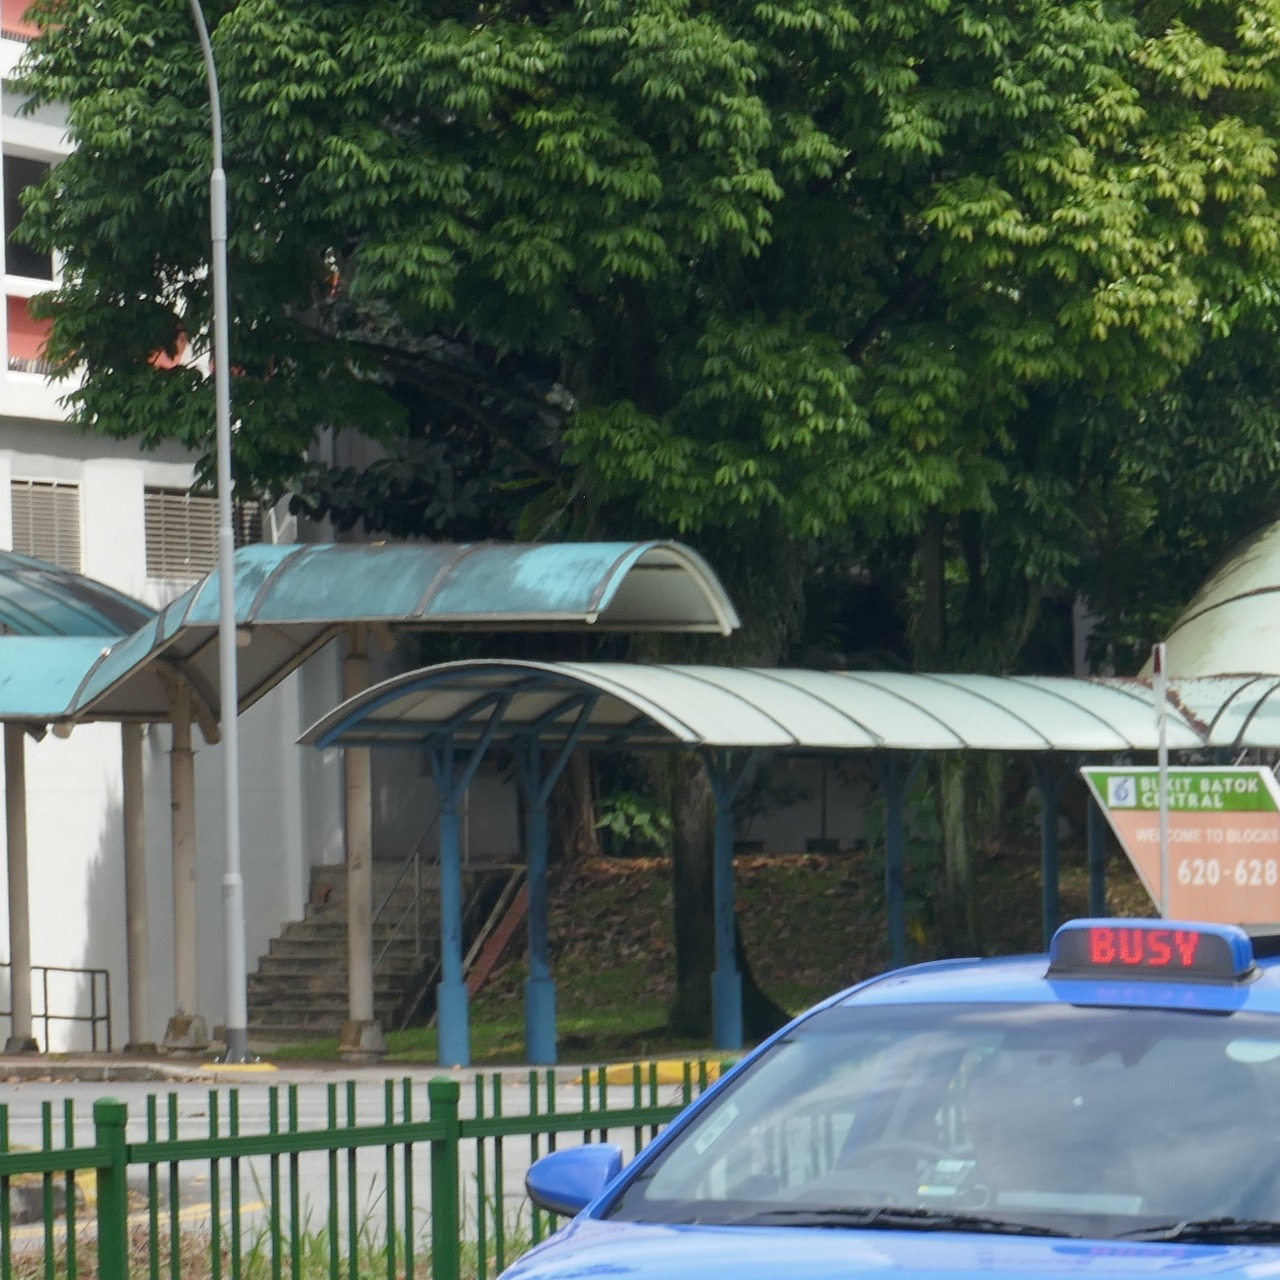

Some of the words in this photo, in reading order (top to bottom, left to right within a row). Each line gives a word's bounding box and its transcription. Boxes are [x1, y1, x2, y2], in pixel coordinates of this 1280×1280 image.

[1200, 777, 1259, 794] BATOK
[1206, 828, 1224, 843] TO
[1226, 828, 1279, 844] BLOCKS
[1178, 858, 1278, 886] 620-628
[1089, 927, 1199, 967] BUSY
